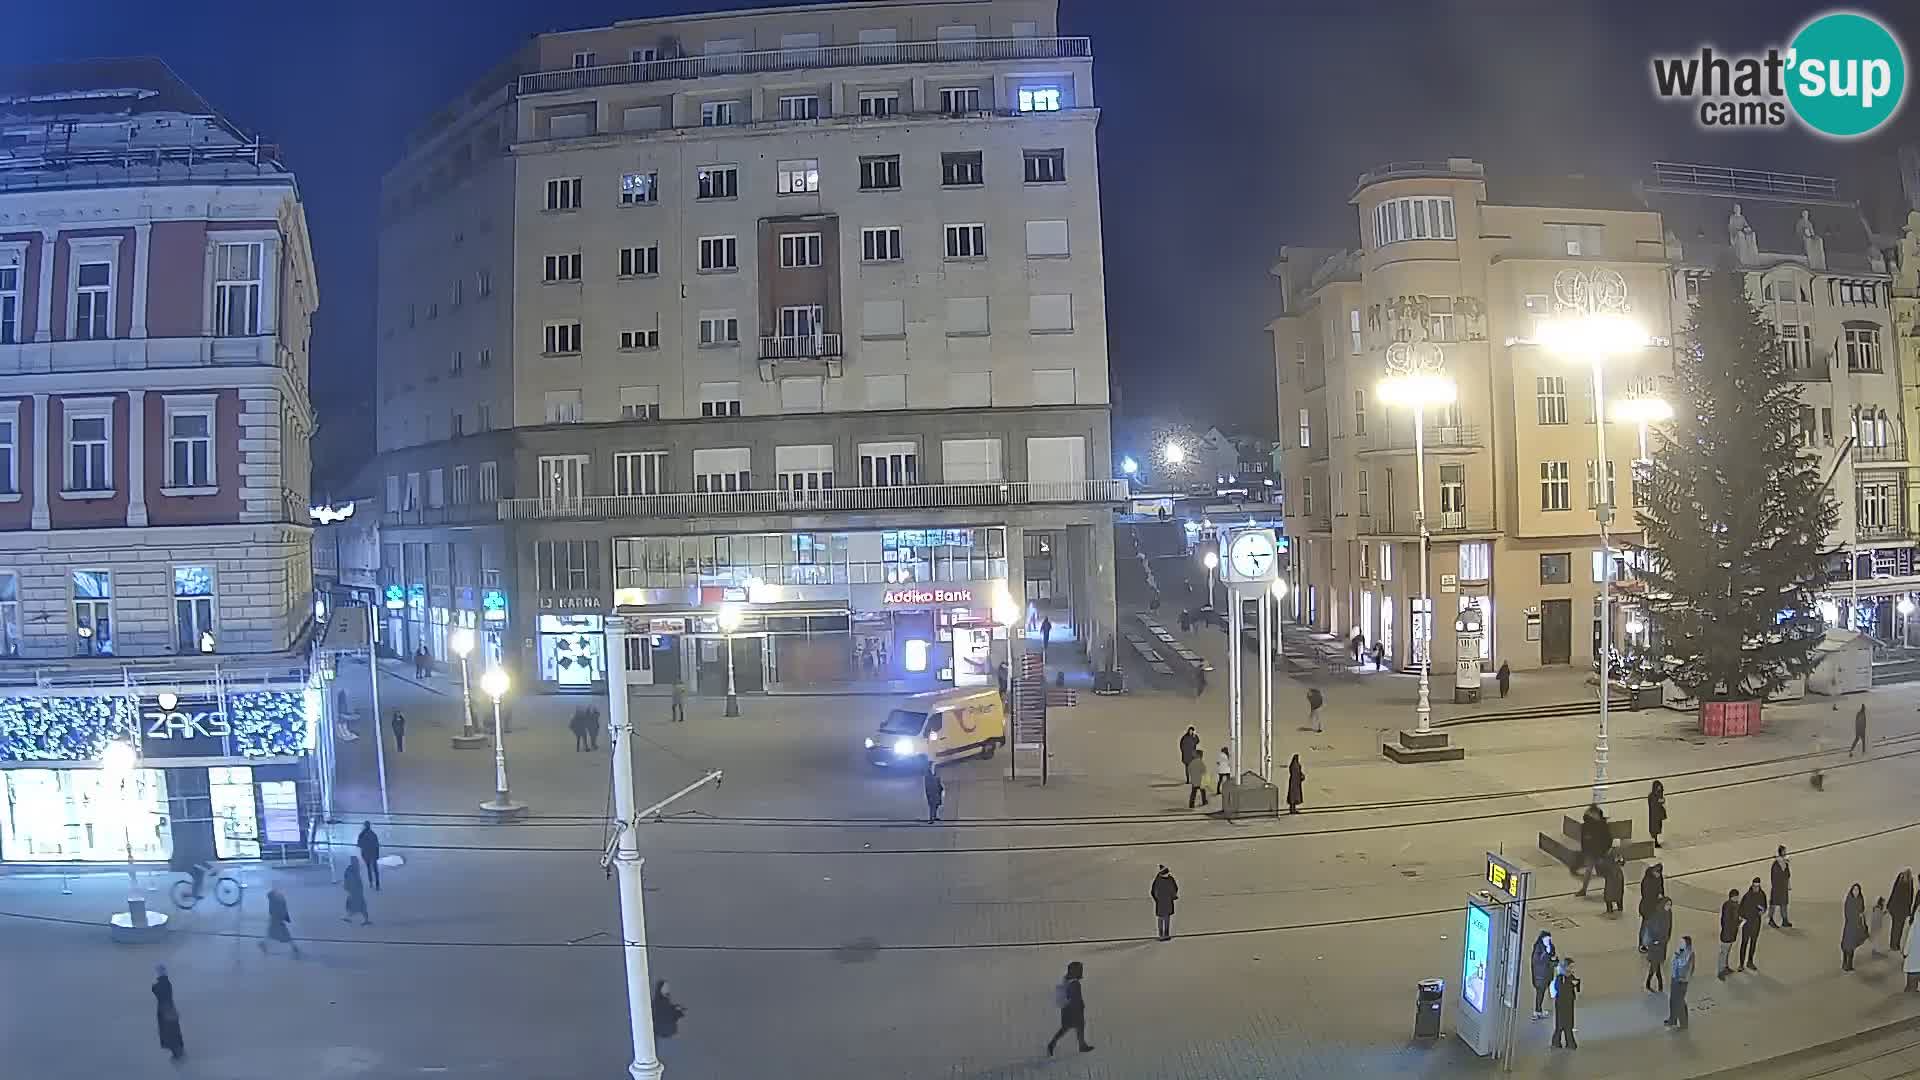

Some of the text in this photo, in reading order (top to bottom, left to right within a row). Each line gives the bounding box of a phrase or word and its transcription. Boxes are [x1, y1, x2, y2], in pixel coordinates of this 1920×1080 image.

[884, 588, 972, 604] Addiko Bank
[143, 711, 231, 739] ZAKS
